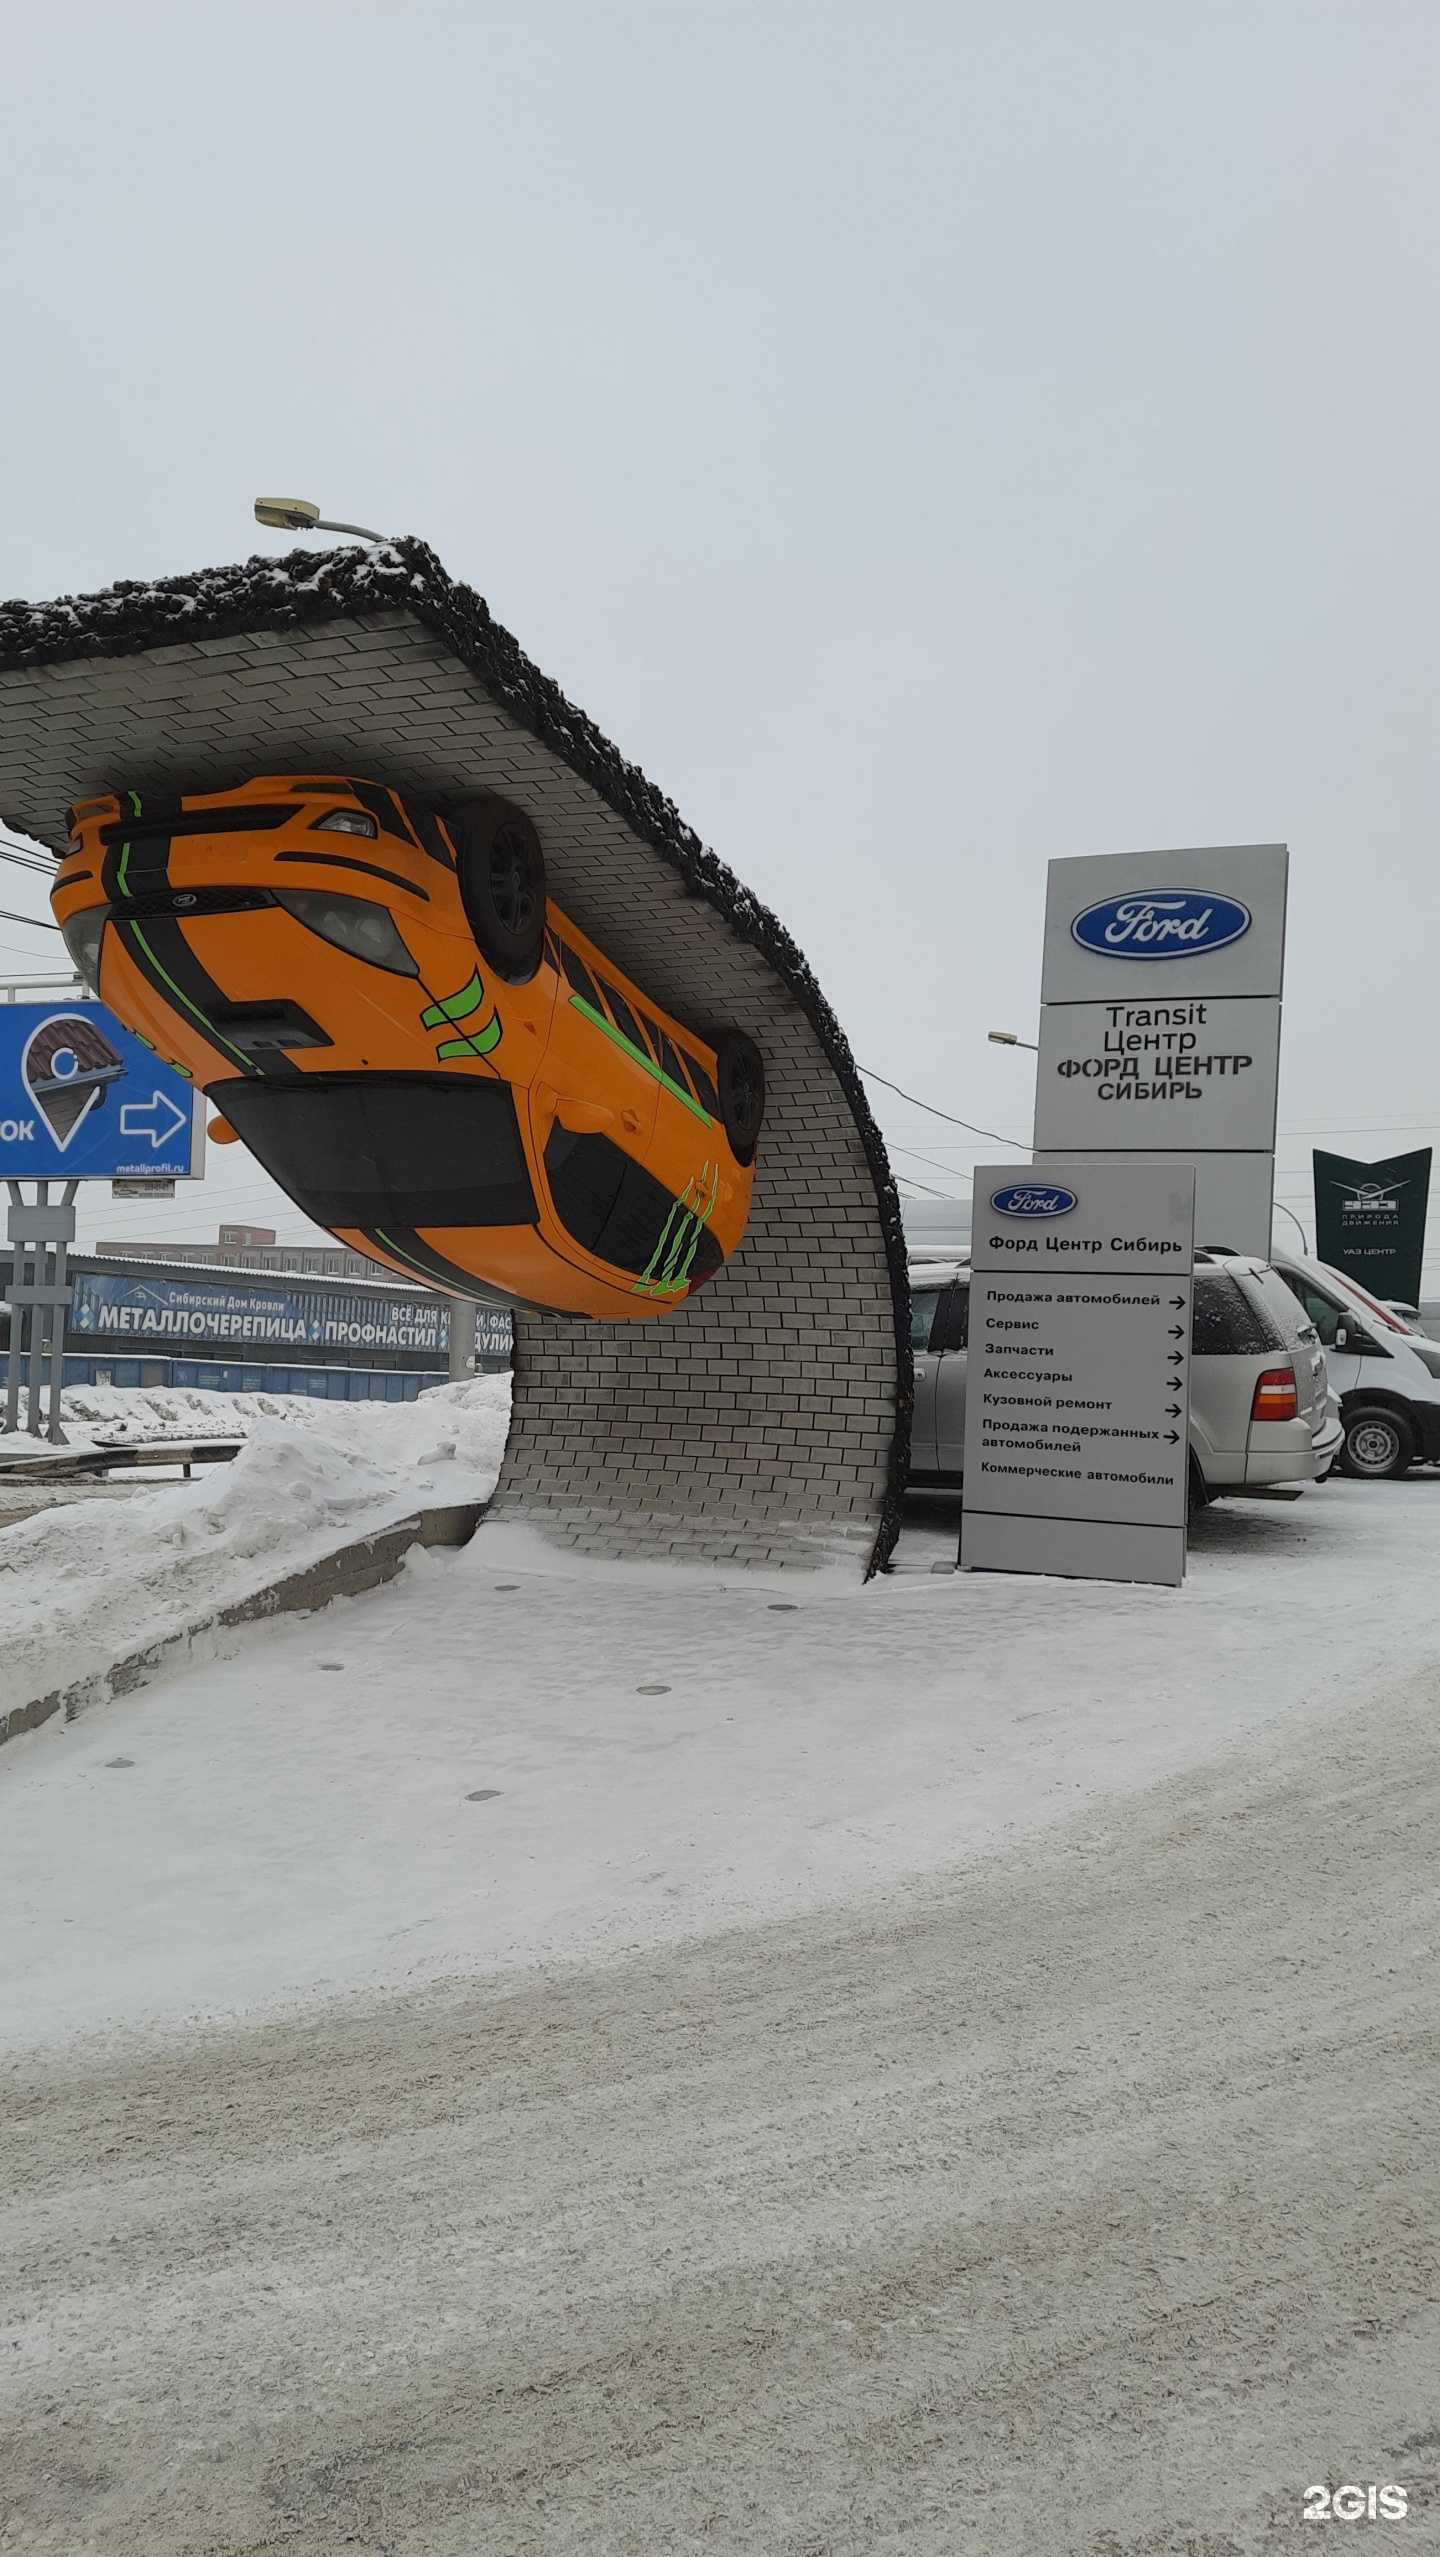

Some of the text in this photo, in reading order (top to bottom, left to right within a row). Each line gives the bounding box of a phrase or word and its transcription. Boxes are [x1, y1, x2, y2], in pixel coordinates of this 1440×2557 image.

[1104, 900, 1214, 943] Ford
[1106, 1003, 1207, 1028] Transit
[1104, 1030, 1197, 1055] Центр
[1057, 1055, 1253, 1080] ФОРД ЦЕНТР
[1097, 1081, 1203, 1101] СИБИРЬ
[0, 1119, 35, 1142] ОК
[116, 1163, 185, 1175] metallprofil.ru
[1008, 1189, 1060, 1211] Ford
[988, 1235, 1183, 1255] Форд Центр Сибирь
[1363, 1248, 1397, 1256] ЦЕНТР
[169, 1291, 285, 1312] Сибирский Дом Кровли
[987, 1290, 1161, 1306] Продажа автомобилей
[98, 1305, 307, 1342] МЕТАЛЛОЧЕРЕПИЦА
[391, 1306, 412, 1322] ВСЁ
[414, 1310, 437, 1325] ДЛЯ
[985, 1317, 1040, 1331] Сервис
[325, 1320, 436, 1347] ПРОФНАСТИЛ
[984, 1343, 1055, 1356] Запчасти
[983, 1368, 1073, 1383] Аксессуары
[983, 1393, 1113, 1410] Кузовной ремонт
[982, 1418, 1160, 1440] Продажа подержанных
[981, 1438, 1082, 1453] автомобилей
[981, 1462, 1175, 1486] Коммерческие автомобили
